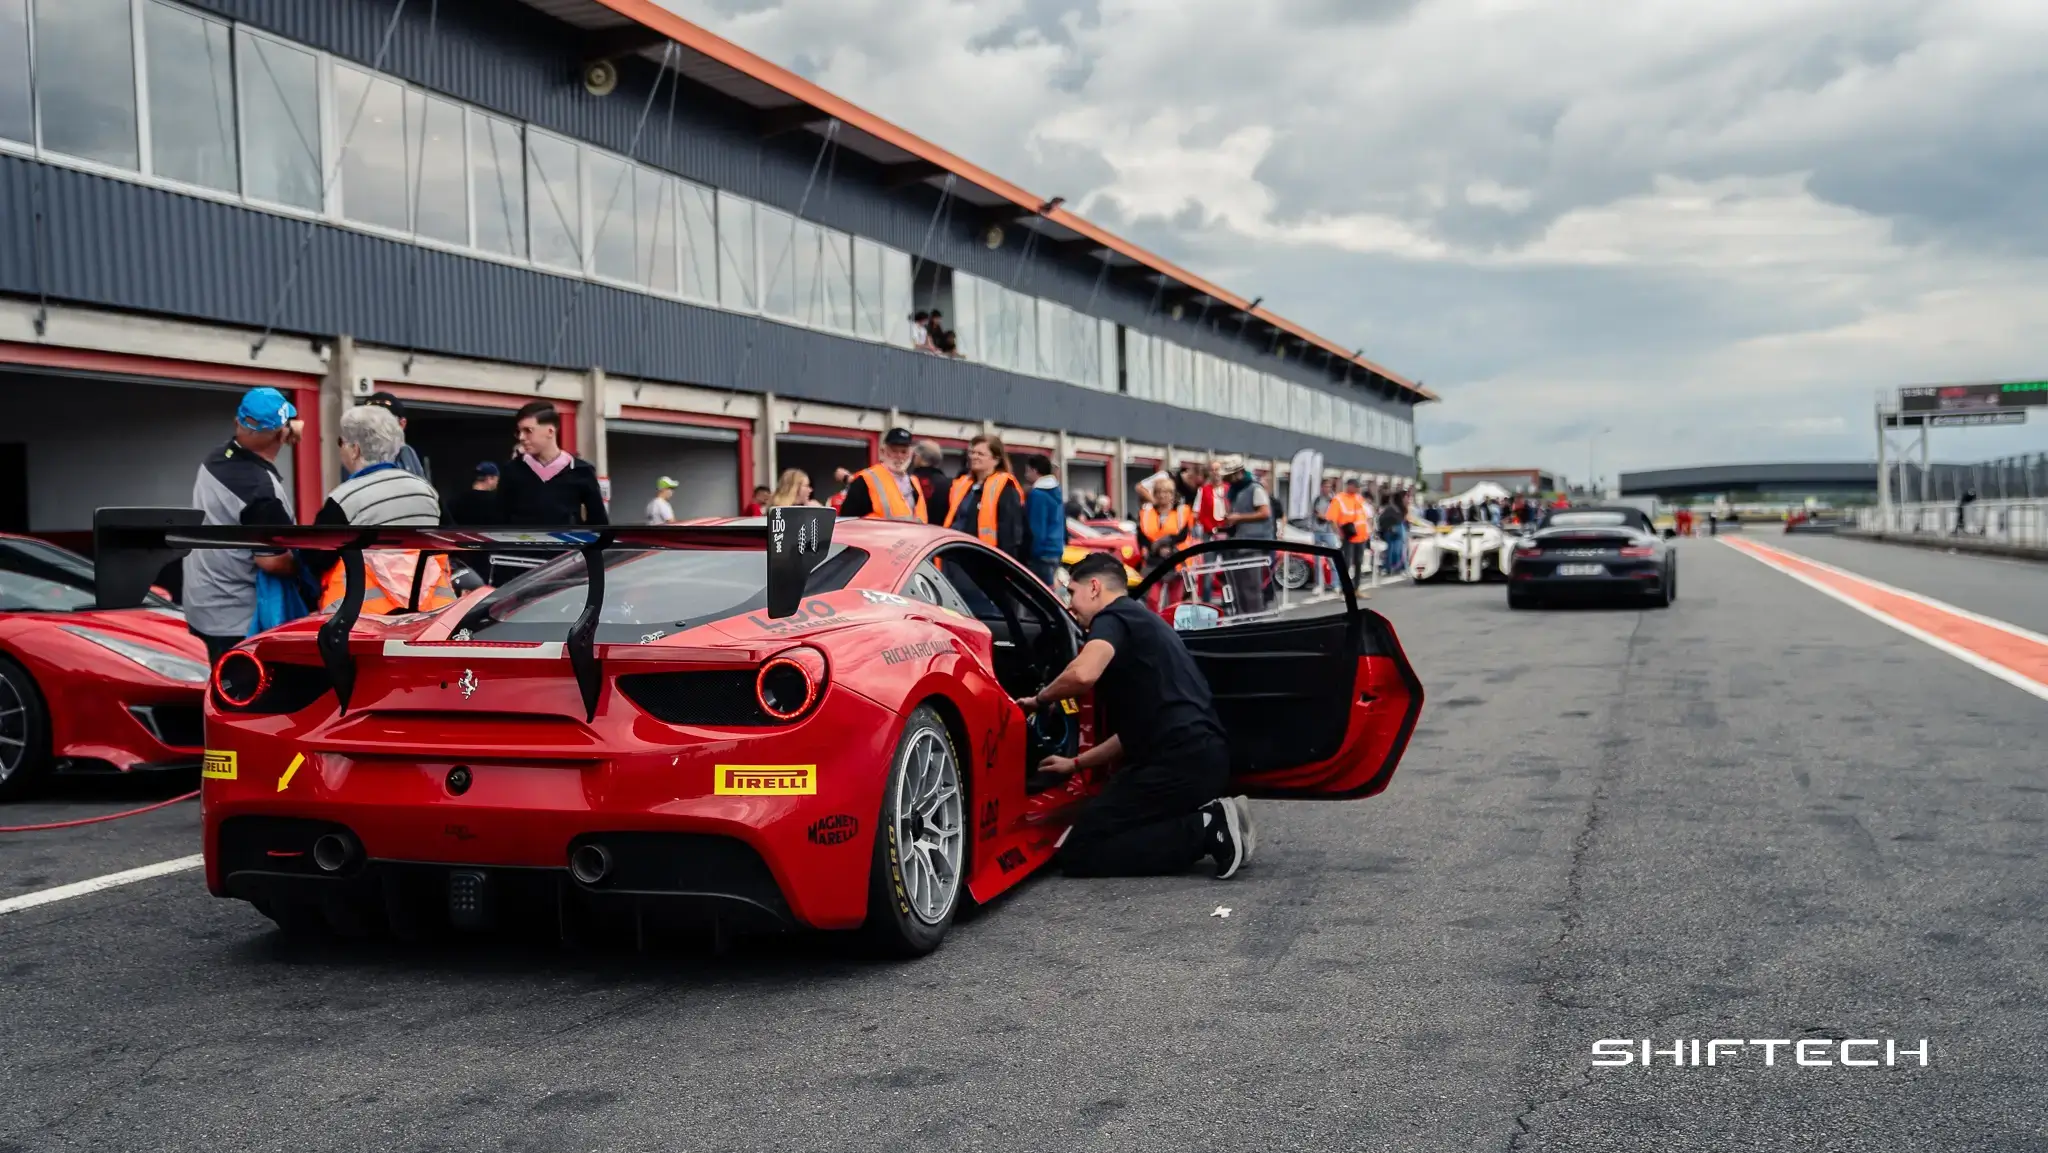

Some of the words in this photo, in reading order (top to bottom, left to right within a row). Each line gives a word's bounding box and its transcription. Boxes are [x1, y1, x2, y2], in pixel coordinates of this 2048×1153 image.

[360, 378, 368, 392] 6
[772, 519, 786, 532] LDO
[881, 642, 933, 665] RICHARD
[204, 754, 232, 773] RELLI
[725, 770, 808, 788] PIRELLI
